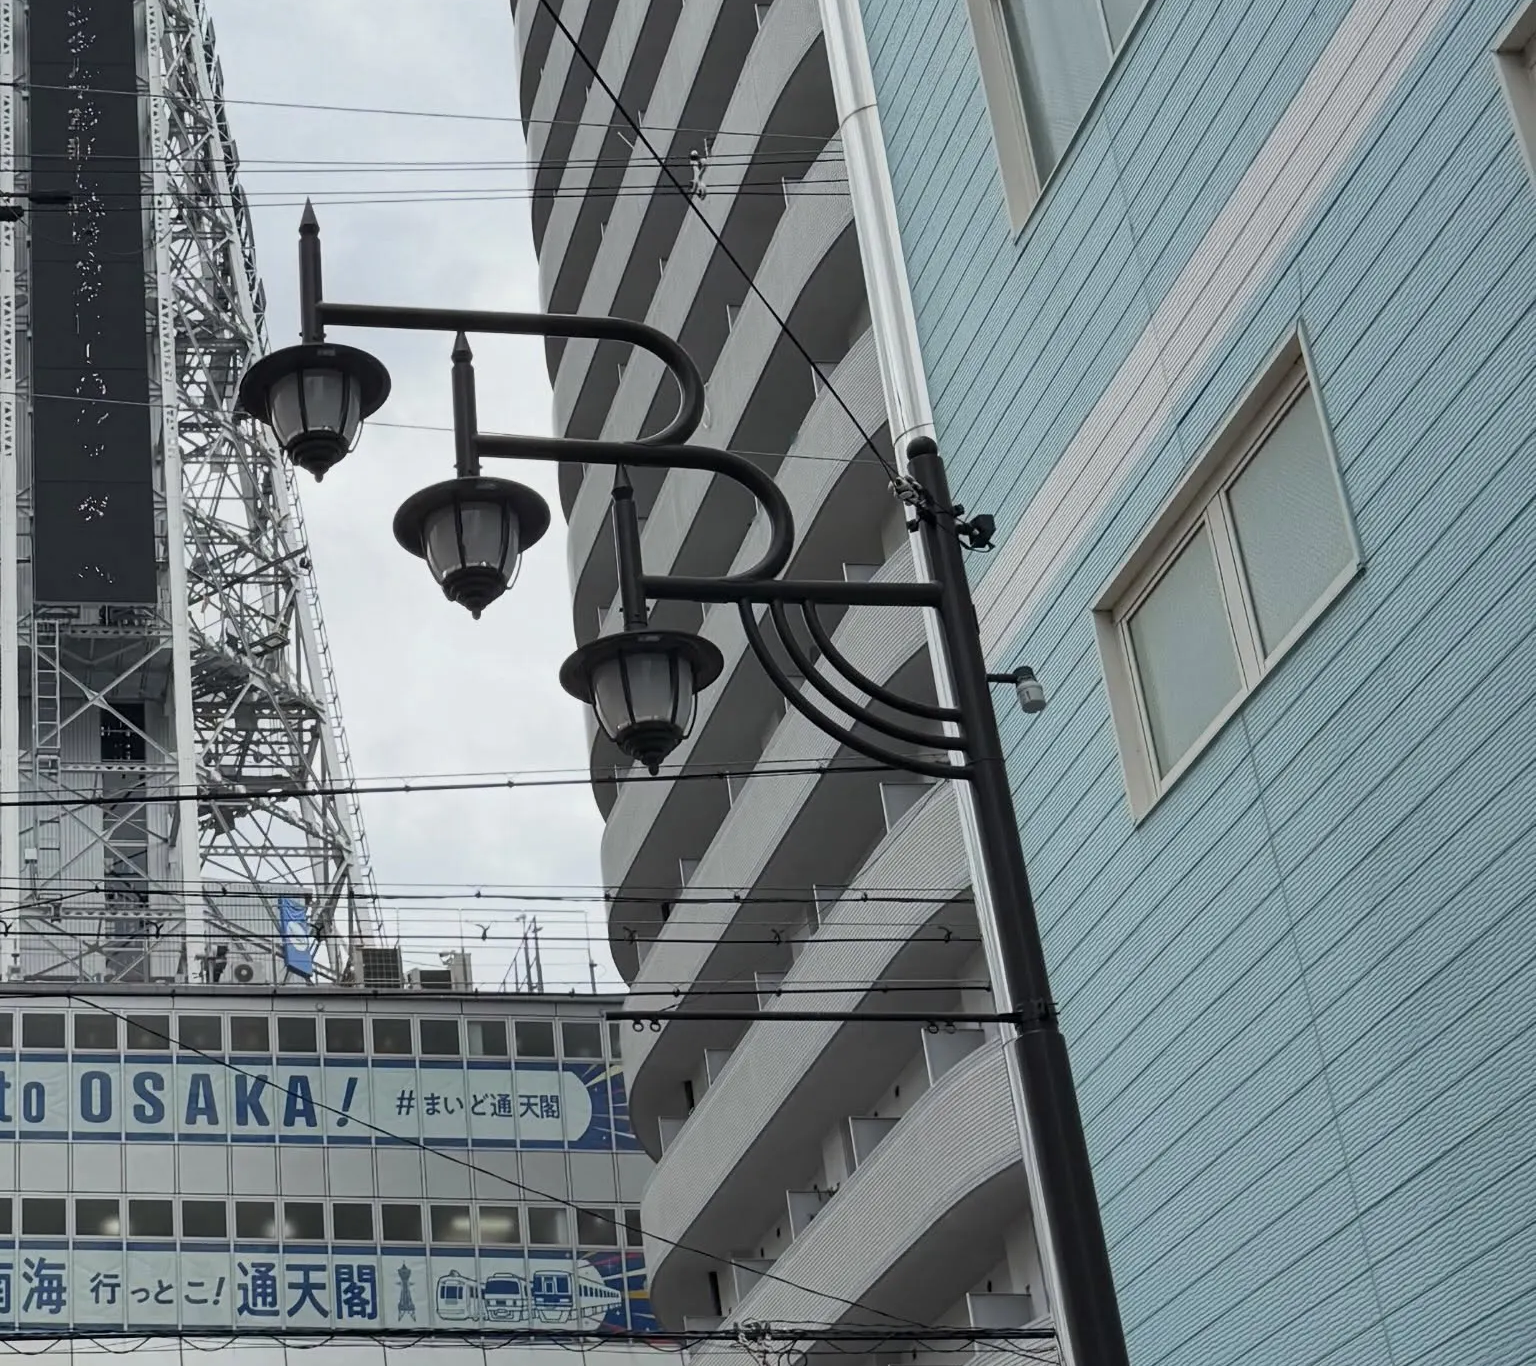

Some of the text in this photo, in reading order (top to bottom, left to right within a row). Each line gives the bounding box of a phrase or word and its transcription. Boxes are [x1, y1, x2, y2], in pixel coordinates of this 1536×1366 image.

[79, 1070, 359, 1128] OSAKA!
[395, 1088, 562, 1120] #まいど通天閣
[89, 1271, 227, 1306] 行っとこ!
[236, 1260, 378, 1321] 通天閣
